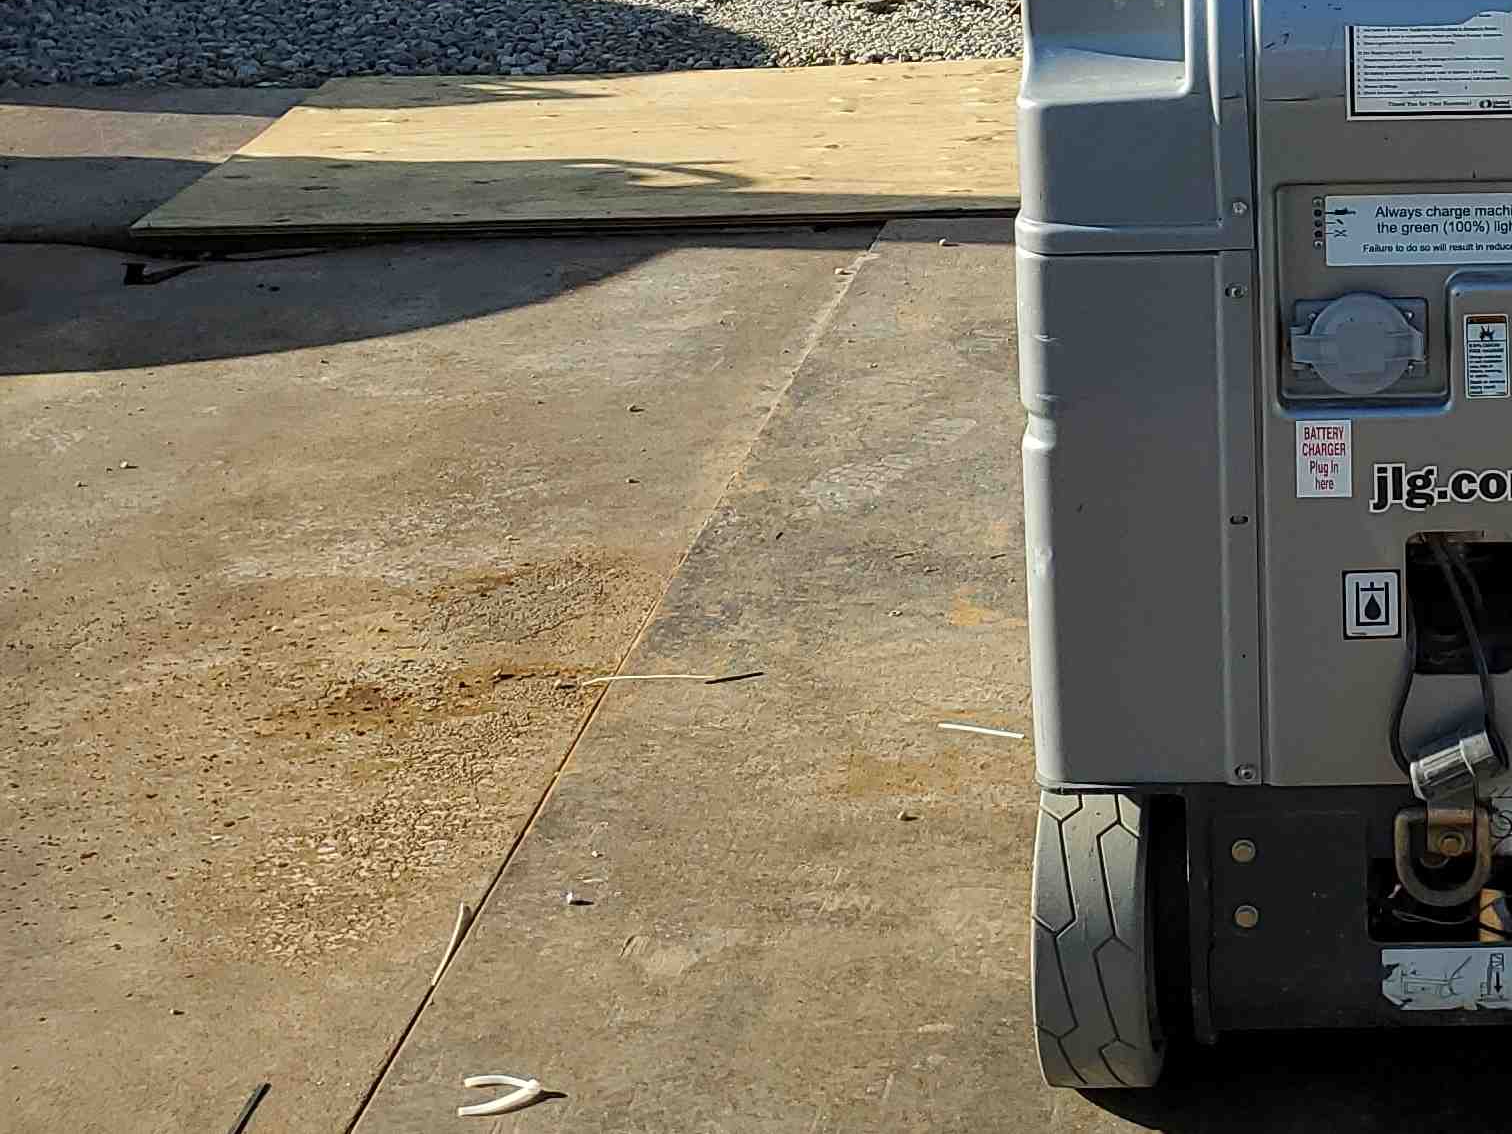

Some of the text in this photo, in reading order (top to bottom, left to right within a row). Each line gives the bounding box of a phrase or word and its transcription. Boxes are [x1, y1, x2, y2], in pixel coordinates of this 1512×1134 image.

[1375, 205, 1423, 220] Always
[1425, 205, 1471, 220] charge
[1376, 221, 1398, 234] the
[1401, 222, 1439, 236] green
[1442, 220, 1490, 236] (100%)
[1363, 243, 1393, 253] Failure
[1395, 243, 1404, 252] to
[1406, 243, 1418, 252] do
[1433, 243, 1447, 252] will
[1449, 242, 1474, 251] result
[1475, 241, 1484, 251] in
[1304, 426, 1344, 440] BATTERY
[1302, 442, 1346, 457] CHARGER
[1310, 459, 1329, 477] Plug
[1315, 477, 1335, 491] here
